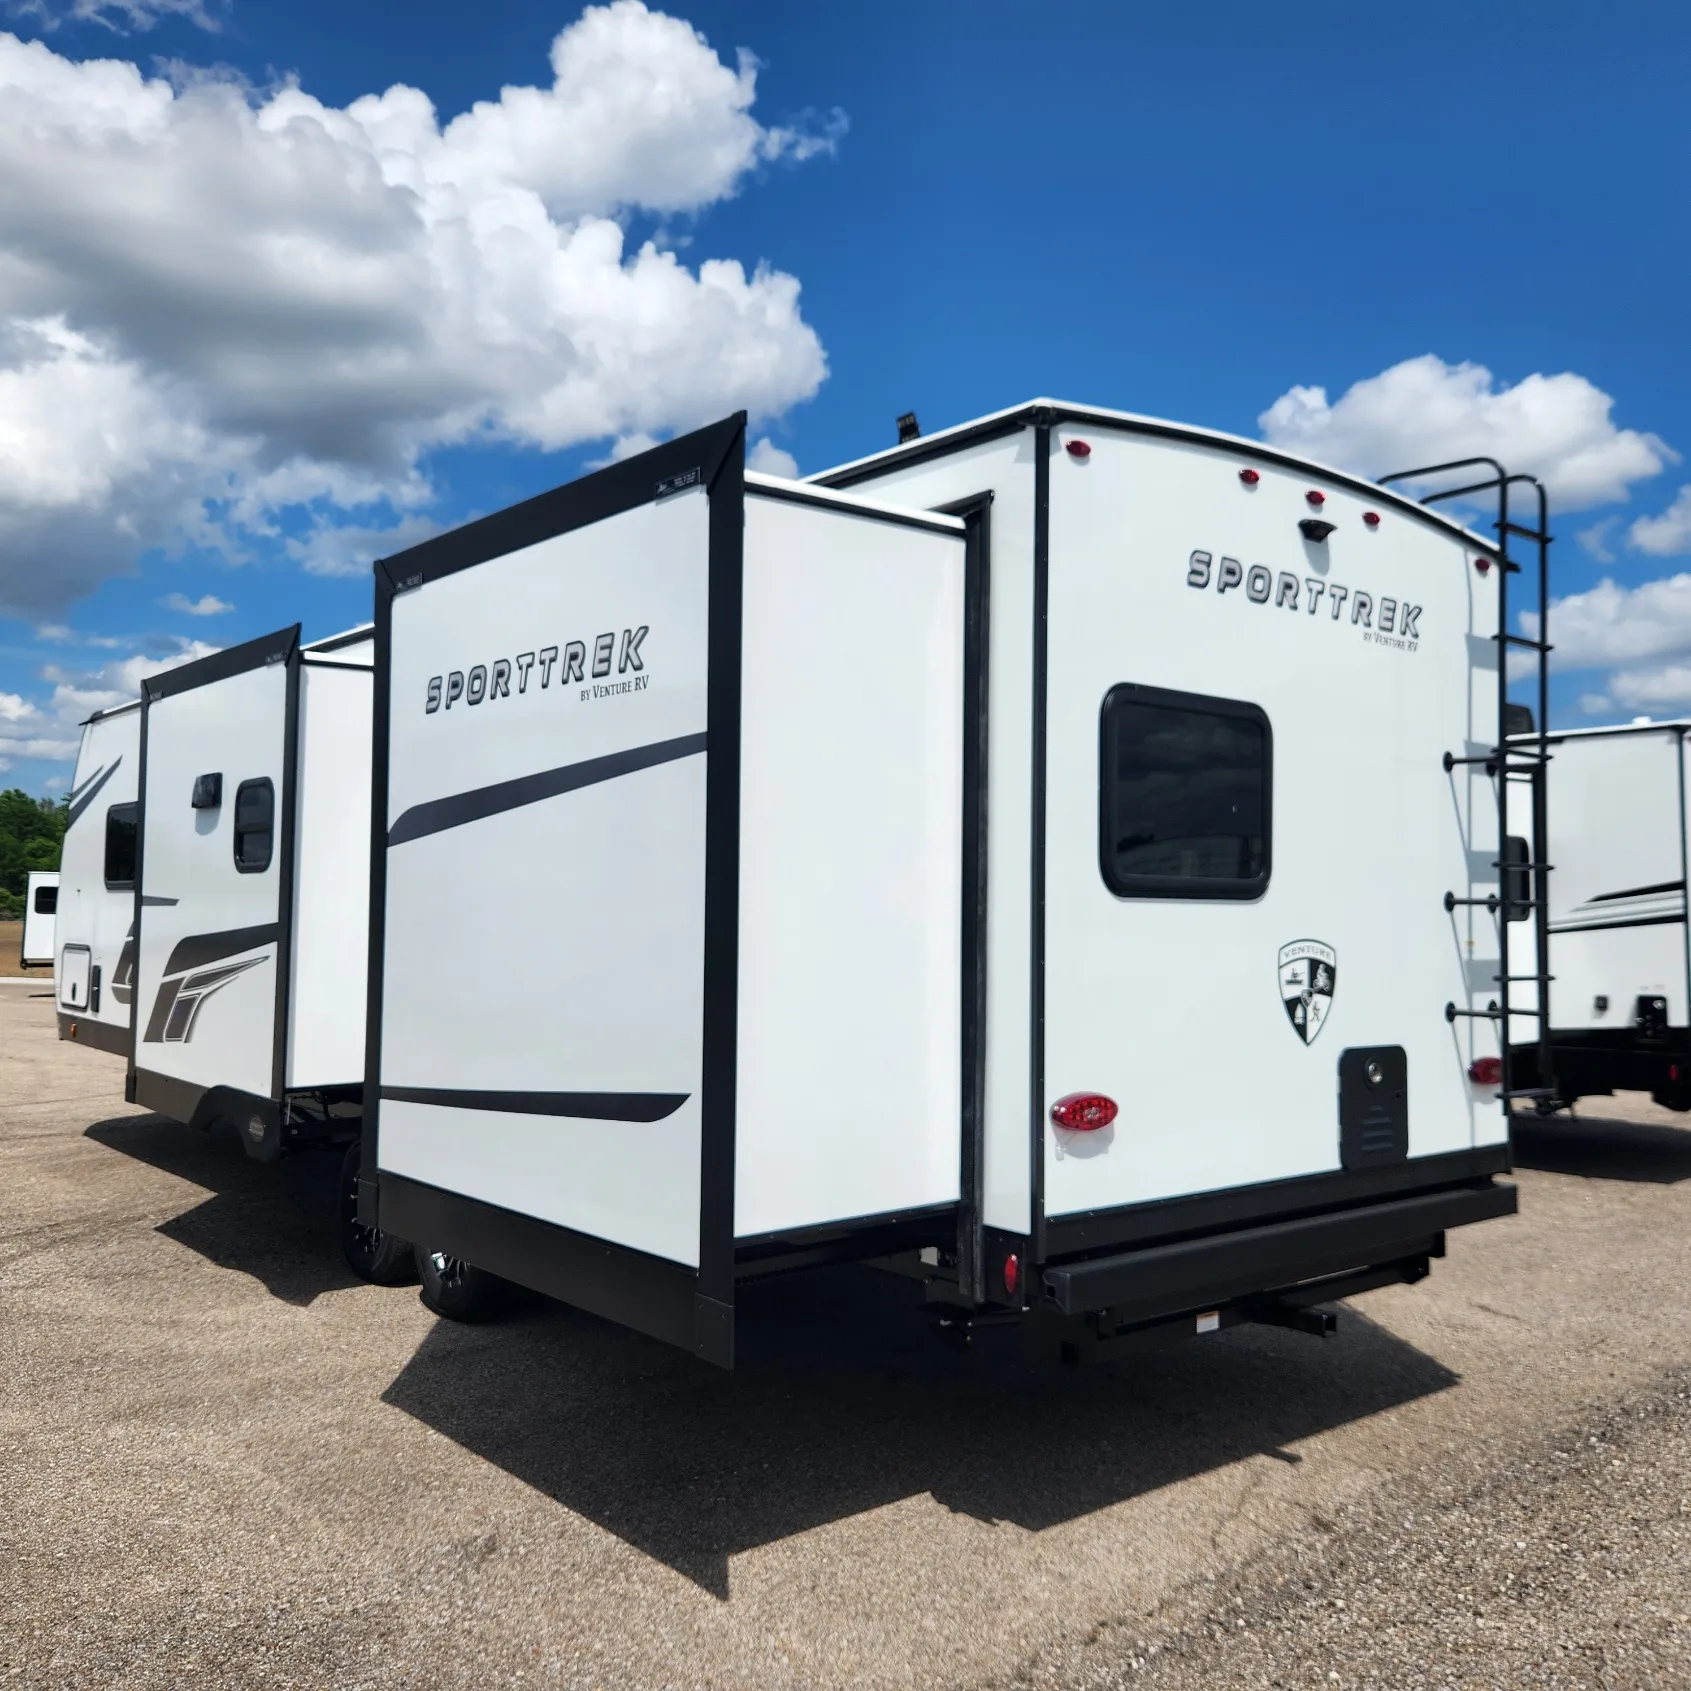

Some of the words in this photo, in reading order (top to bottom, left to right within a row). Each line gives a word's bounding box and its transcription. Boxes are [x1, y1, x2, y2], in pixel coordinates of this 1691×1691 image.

[1186, 549, 1423, 639] SPORTTREK
[1407, 640, 1419, 652] RV
[425, 625, 650, 715] SPORTTREK
[592, 681, 633, 699] VENTURE
[634, 674, 650, 691] RV
[1283, 945, 1333, 960] VENTURE
